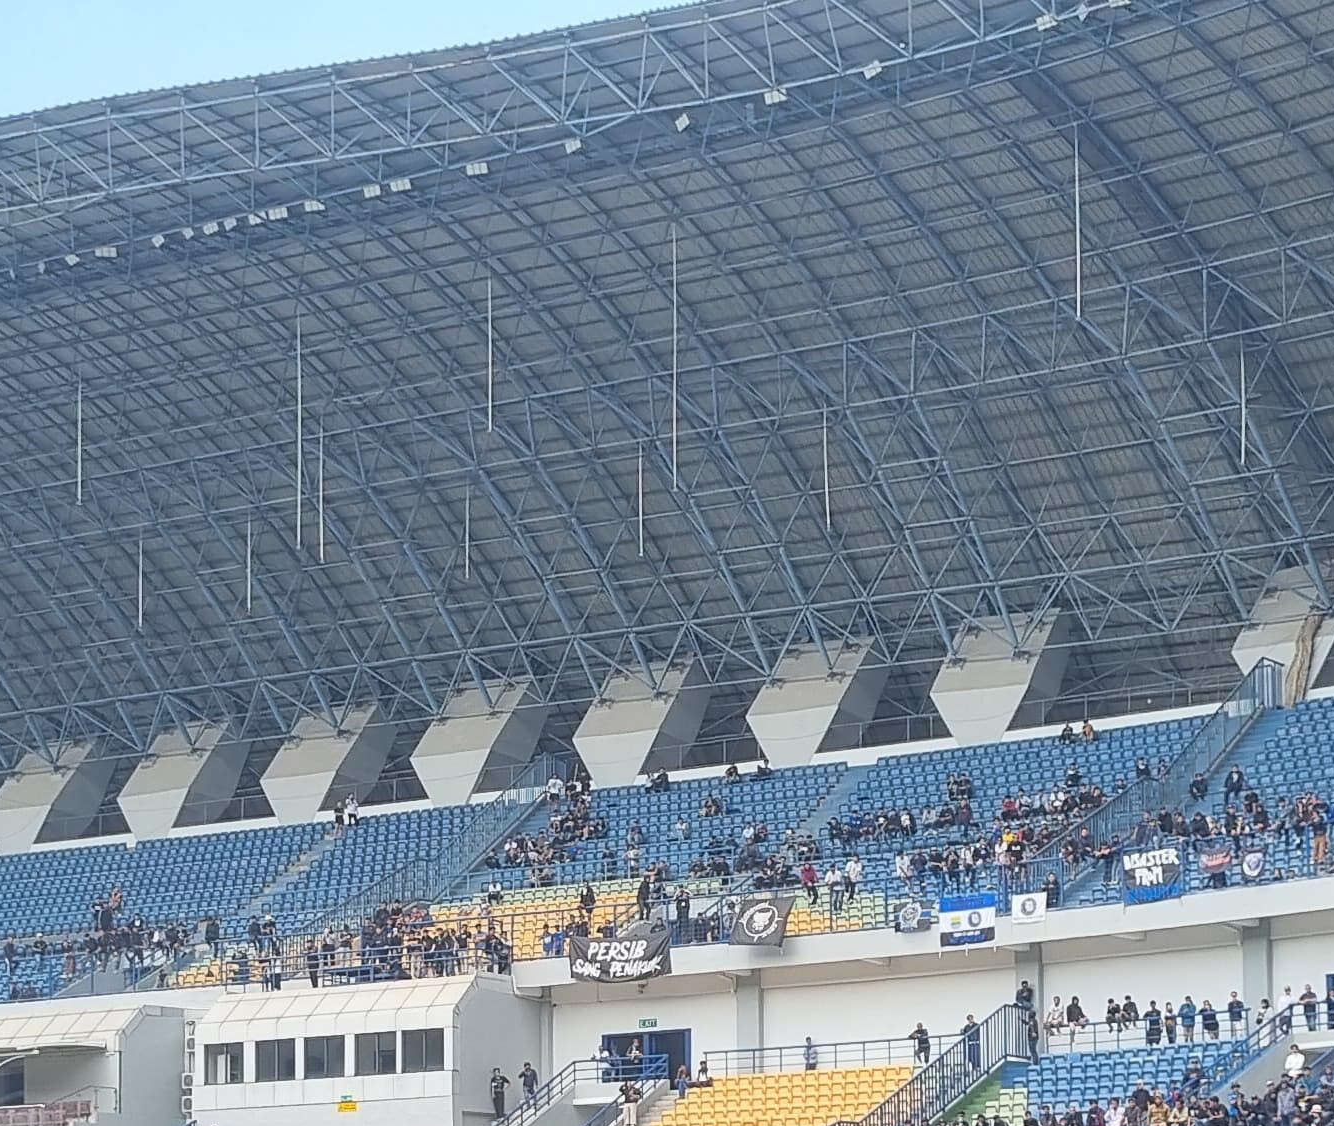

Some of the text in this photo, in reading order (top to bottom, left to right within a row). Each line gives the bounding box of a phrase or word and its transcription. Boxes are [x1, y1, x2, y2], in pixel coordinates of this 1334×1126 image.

[1123, 848, 1180, 870] DISASTER
[587, 939, 649, 961] PERSIB
[572, 958, 602, 977] SANG
